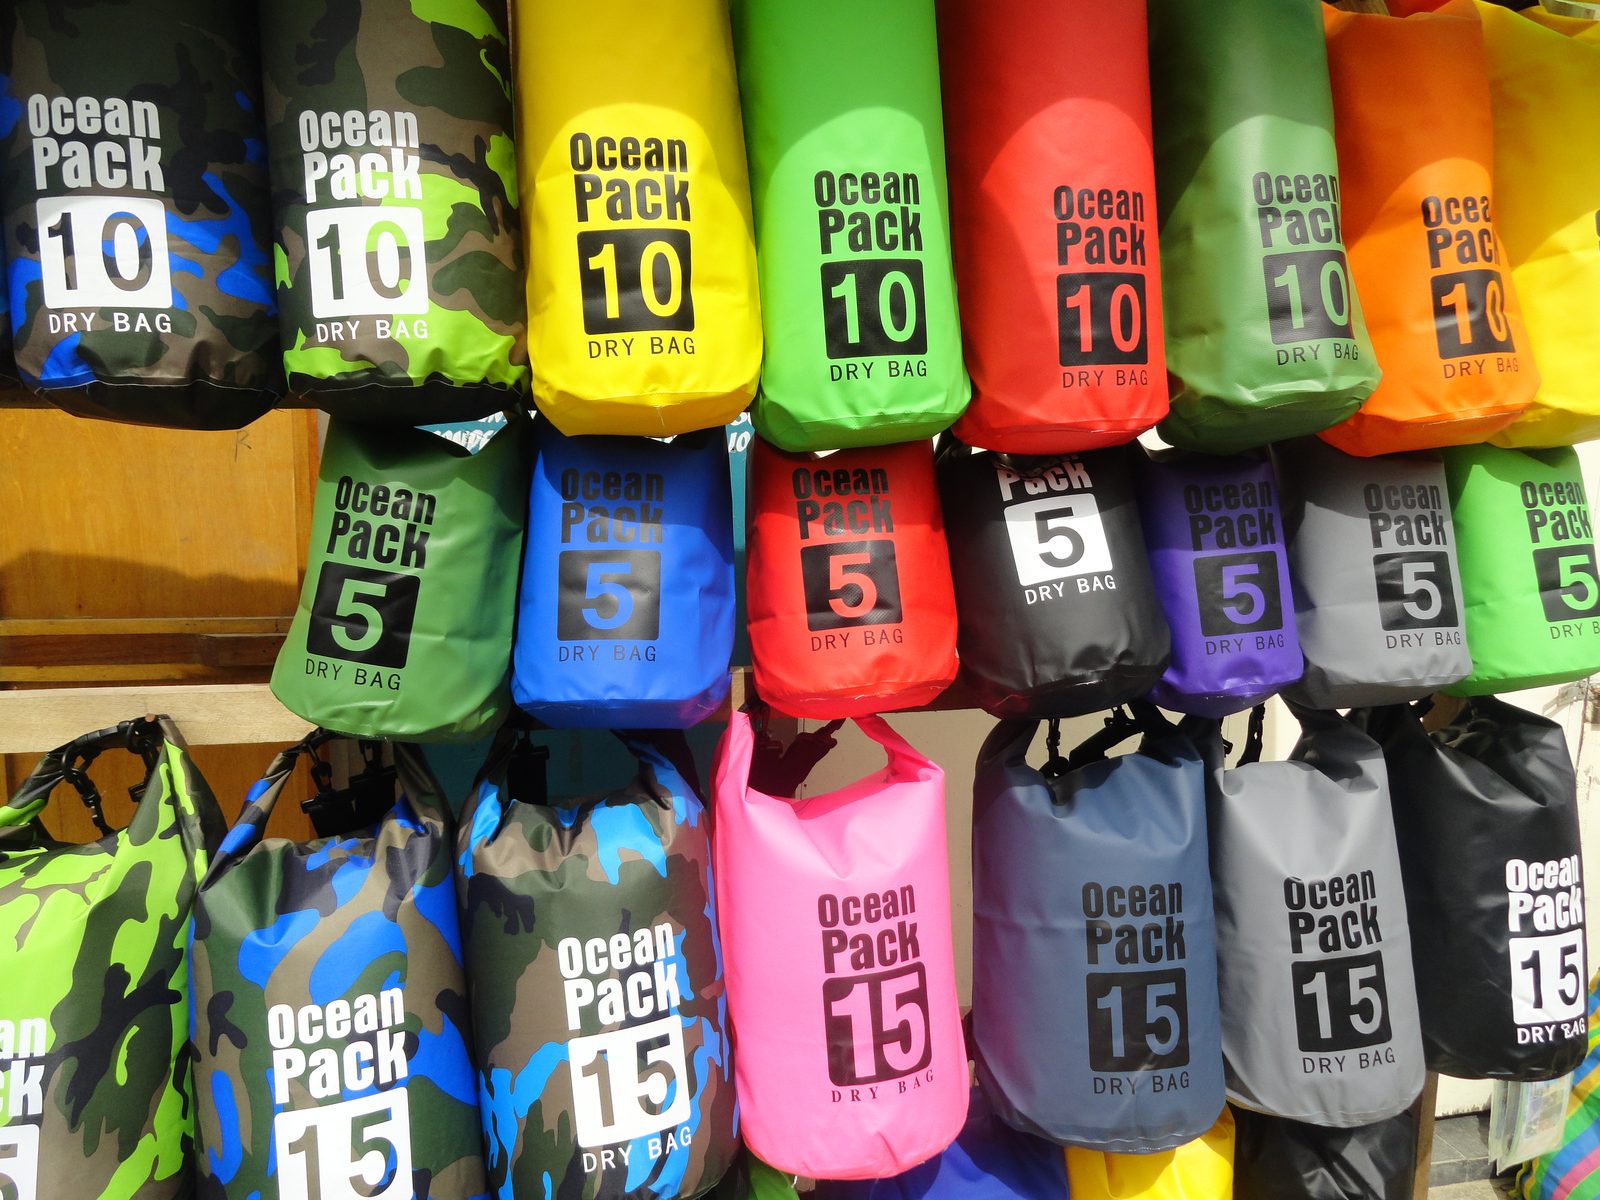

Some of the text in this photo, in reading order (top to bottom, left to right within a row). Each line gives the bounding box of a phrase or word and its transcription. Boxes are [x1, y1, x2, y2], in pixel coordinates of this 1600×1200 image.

[28, 94, 161, 139] Ocean
[299, 109, 420, 152] Ocean
[32, 137, 165, 192] Pack
[570, 132, 688, 173] Ocean
[303, 147, 423, 204] Pack
[574, 173, 691, 223] Pack
[813, 170, 920, 208] Ocean
[1053, 185, 1144, 222] Ocean
[1421, 195, 1492, 228] Ocea
[47, 211, 153, 291] 10
[818, 205, 923, 254] Pack
[1056, 222, 1146, 266] Pack
[1426, 227, 1500, 270] Pac
[316, 220, 412, 300] 10
[588, 240, 681, 319] 10
[831, 270, 917, 344] 10
[1274, 260, 1348, 330] 10
[1441, 280, 1507, 345] 10
[48, 312, 172, 334] DRY BAG
[316, 319, 429, 343] DRY BAG
[1066, 283, 1141, 353] 10
[588, 337, 695, 359] DRY BAG
[1276, 342, 1359, 366] DRY BAG
[1443, 357, 1519, 379] DRY BAG
[830, 360, 928, 382] DRY BAG
[1062, 369, 1148, 388] DRY BAG
[334, 475, 436, 525] Ocean
[561, 468, 664, 502] Ocean
[792, 467, 889, 500] Ocean
[1184, 481, 1273, 514] Ocean
[1363, 483, 1441, 512] Ocean
[1520, 481, 1585, 509] Ocean
[561, 501, 663, 545] Pack
[796, 495, 894, 540] Pack
[1035, 506, 1085, 568] 5
[1188, 509, 1277, 552] Pack
[1368, 511, 1448, 548] Pack
[1526, 506, 1593, 543] Pack
[325, 511, 431, 570] Pack
[581, 561, 635, 630] 5
[828, 551, 877, 618] 5
[1024, 575, 1116, 605] DRY BAG
[1222, 563, 1266, 625] 5
[1402, 562, 1442, 620] 5
[1558, 554, 1599, 611] 5
[330, 577, 386, 652] 5
[1549, 623, 1583, 640] DRY
[559, 645, 657, 663] DRY BAG
[811, 628, 904, 652] DRY BAG
[1205, 634, 1285, 656] DRY BAG
[1385, 631, 1461, 650] DRY BAG
[305, 658, 401, 691] DRY BAG
[1283, 868, 1377, 911] Ocean
[1505, 854, 1580, 892] Ocean
[818, 883, 916, 928] Ocean
[1081, 880, 1183, 919] Ocean
[1508, 884, 1583, 932] Pack
[558, 922, 675, 980] Ocean
[821, 920, 921, 974] Pack
[1085, 916, 1186, 965] Pack
[1287, 904, 1383, 955] Pack
[563, 960, 681, 1031] Pack
[1520, 943, 1580, 1009] 15
[267, 987, 405, 1049] Ocean
[831, 970, 927, 1079] 15
[1096, 982, 1181, 1058] 15
[1302, 965, 1383, 1039] 15
[1517, 1018, 1586, 1045] DRY BAG
[272, 1028, 408, 1105] Pack
[581, 1033, 677, 1128] 15
[1093, 1071, 1190, 1096] DRY BAG
[1302, 1047, 1396, 1075] DRY BAG
[831, 1069, 934, 1103] DRY BAG
[288, 1106, 398, 1200] 15
[582, 1126, 692, 1173] DRY BAG
